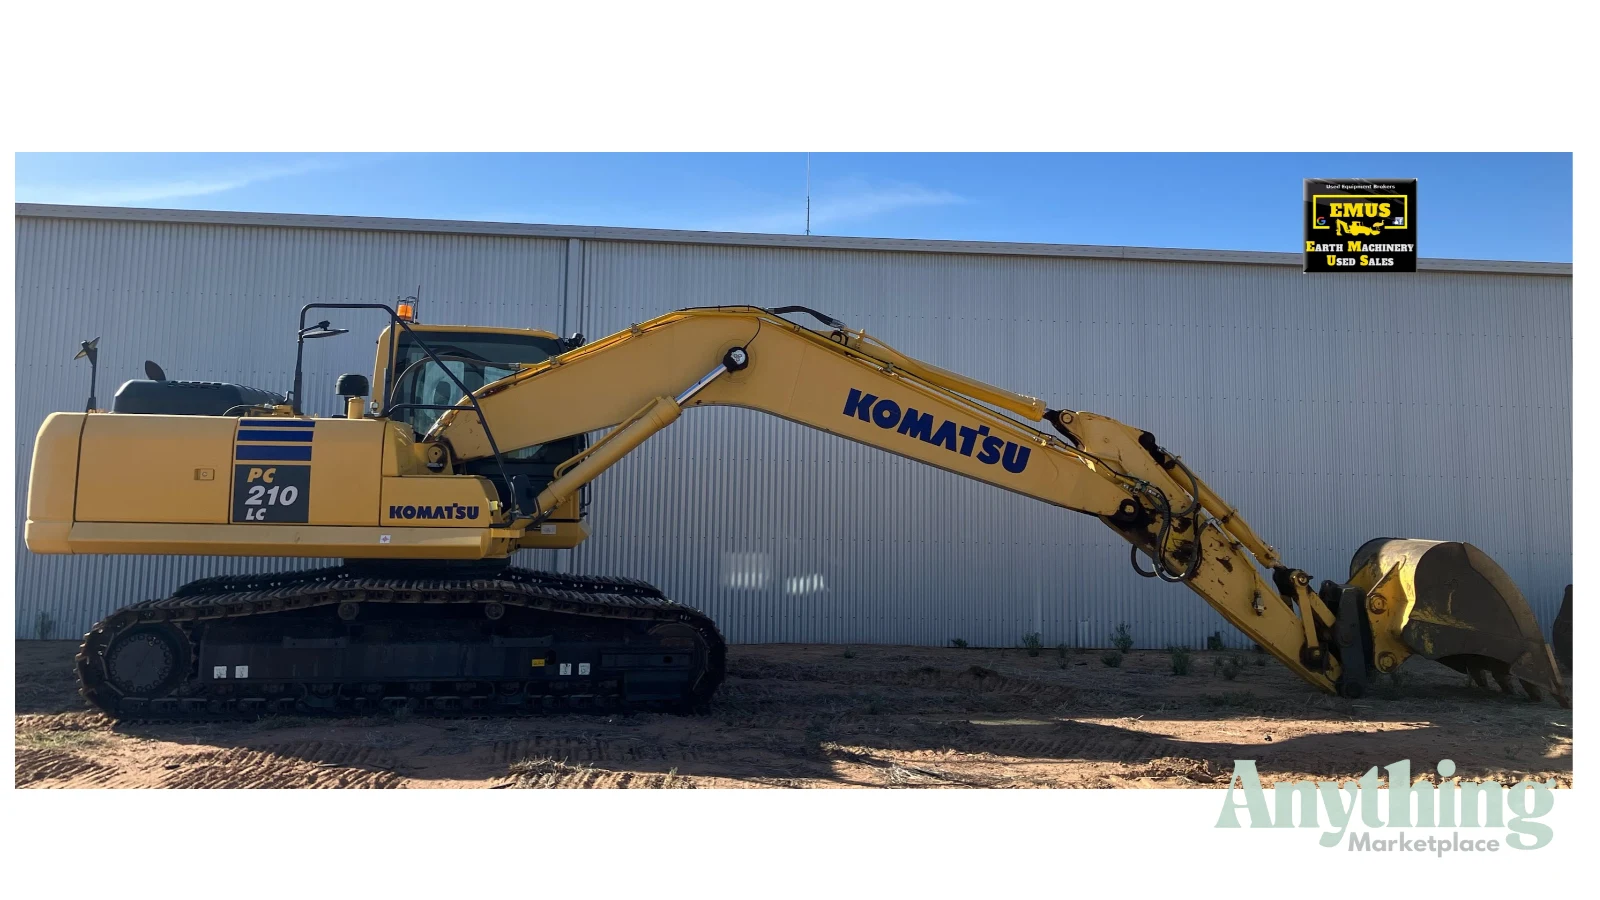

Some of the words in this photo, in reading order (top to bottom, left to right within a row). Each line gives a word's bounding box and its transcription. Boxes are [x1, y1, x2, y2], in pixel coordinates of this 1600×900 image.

[842, 387, 1032, 474] KOMATSU
[246, 467, 277, 483] PC
[244, 485, 298, 506] 210
[245, 508, 267, 521] LC
[389, 502, 480, 520] KOMATSU
